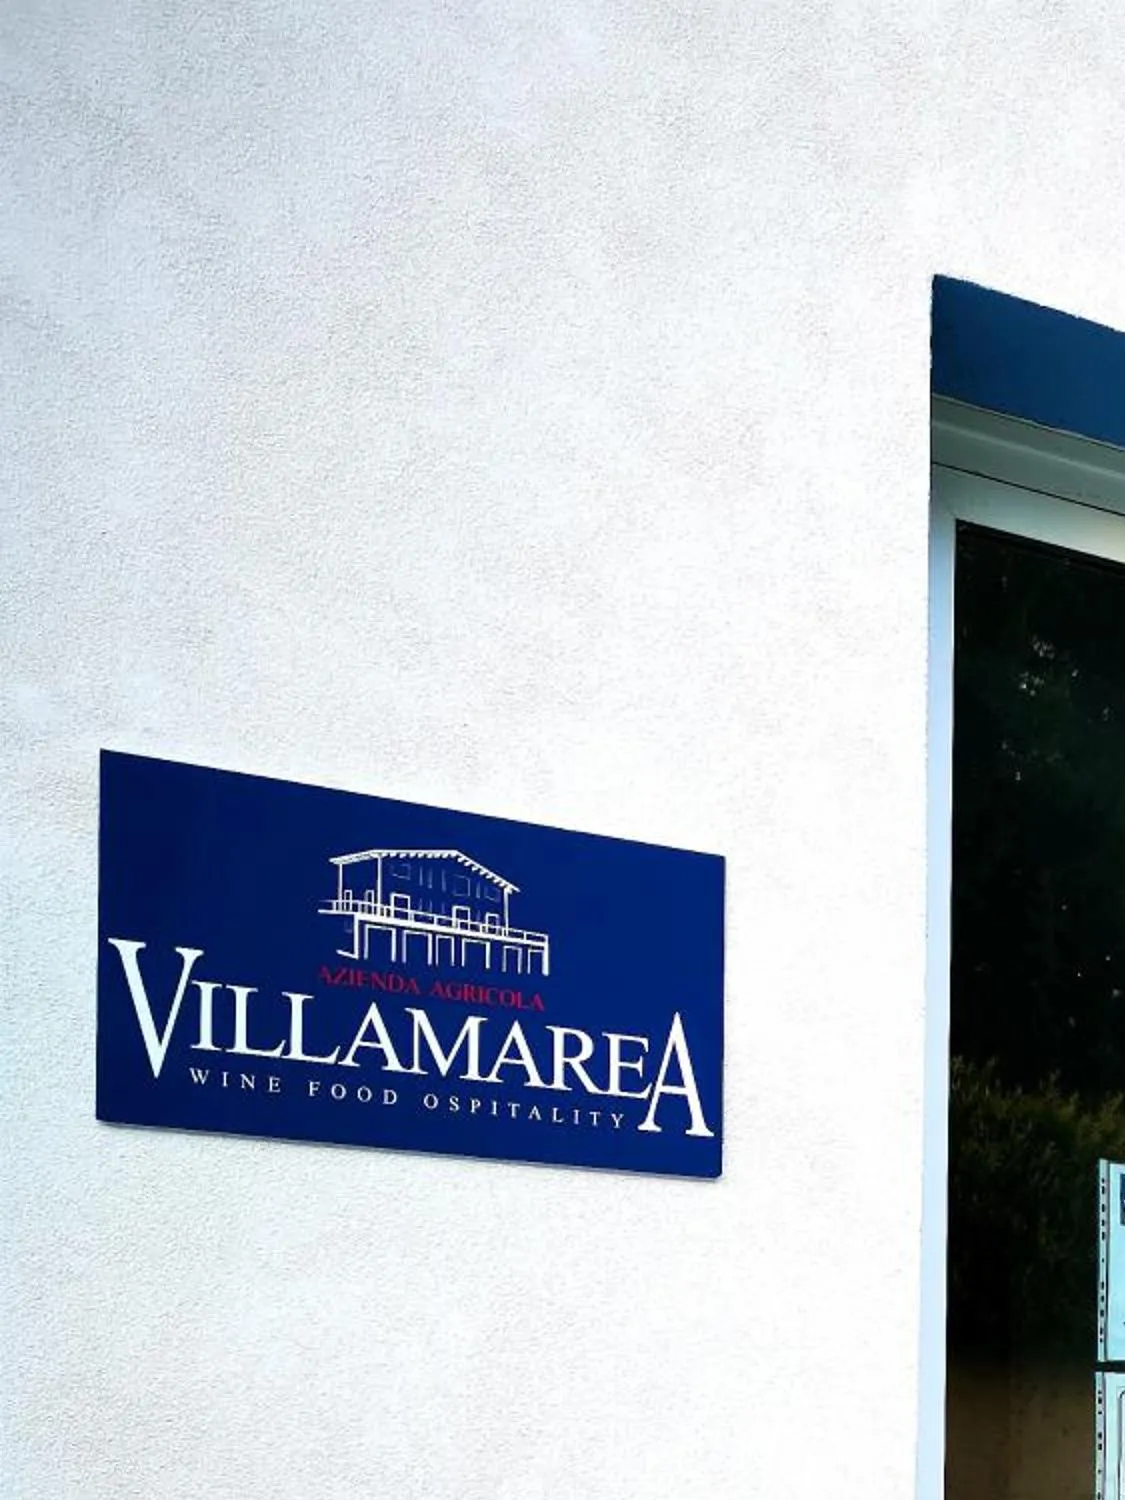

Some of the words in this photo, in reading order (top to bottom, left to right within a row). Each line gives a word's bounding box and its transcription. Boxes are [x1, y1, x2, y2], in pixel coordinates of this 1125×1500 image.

[317, 965, 421, 997] AZIENDA
[430, 979, 546, 1012] AGRICOLA
[107, 937, 715, 1138] VILLAMAREA
[189, 1067, 282, 1094] WINE
[308, 1081, 398, 1106] FOOD
[423, 1094, 626, 1130] OSPITALITY
